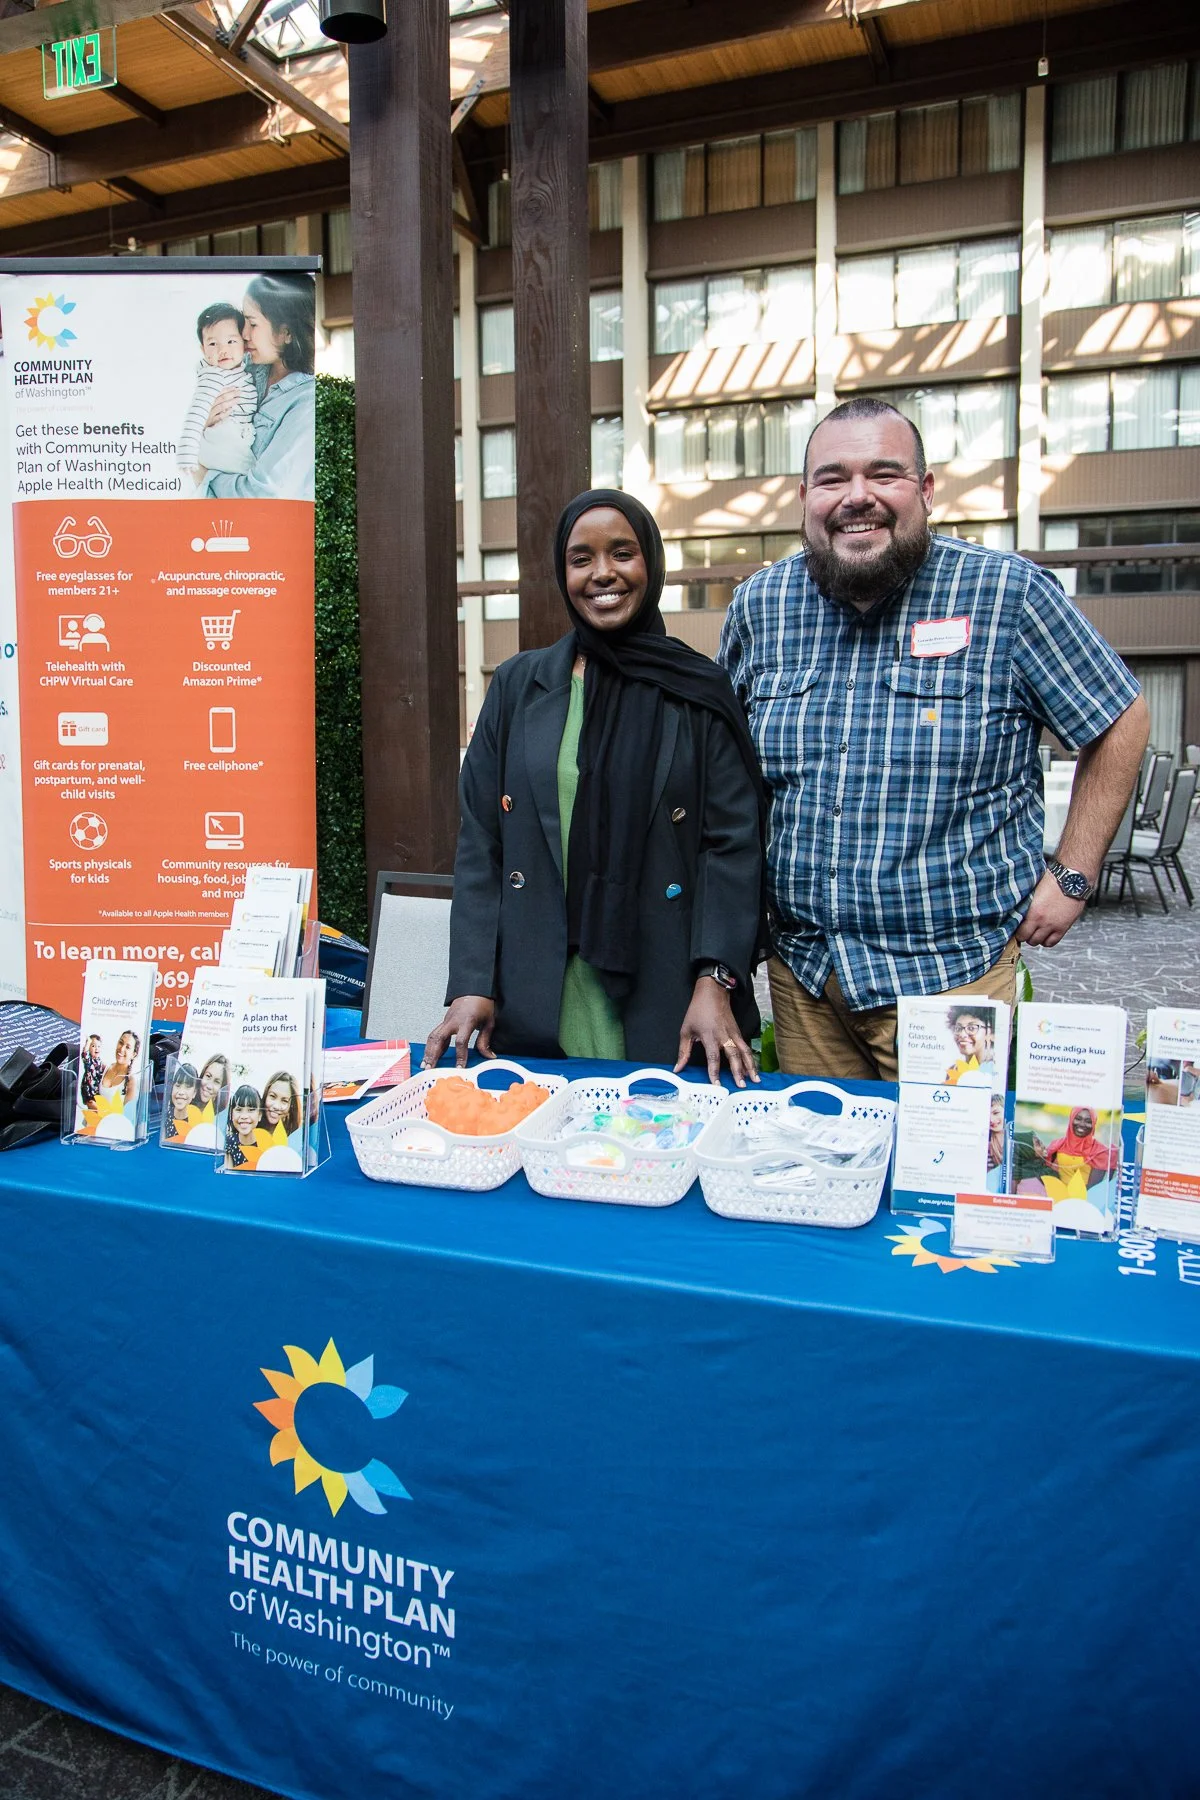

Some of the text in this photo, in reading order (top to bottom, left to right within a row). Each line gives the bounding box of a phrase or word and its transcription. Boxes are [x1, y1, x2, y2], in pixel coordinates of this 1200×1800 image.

[14, 359, 93, 373] COMMUNITY
[14, 372, 93, 386] HEALTH PLAN
[15, 388, 24, 399] of
[16, 422, 145, 438] Get these benefits
[16, 440, 177, 457] with Community Health
[17, 459, 151, 475] Plan of Washington
[17, 477, 182, 494] Apple Health (Medicaid)
[36, 570, 134, 583] Free eyeglasses for
[157, 570, 286, 583] Acupuncture, chiropractic,
[48, 586, 120, 596] members 21+
[166, 586, 278, 598] and massage coverage
[45, 661, 125, 672] Telehealth with
[192, 661, 252, 672] Discounted
[39, 676, 134, 687] CHPW Virtual Care
[182, 676, 225, 687] Amazon
[33, 760, 146, 773] Gift cards for prenatal,
[183, 760, 206, 771] Free
[34, 774, 146, 786] postpartum, and well-
[60, 789, 116, 800] child visits
[49, 858, 132, 871] Sports physicals
[161, 859, 290, 872] Community resources for
[70, 873, 110, 884] for kids
[157, 873, 202, 886] housing,
[203, 873, 230, 885] food,
[231, 873, 247, 885] job
[202, 888, 245, 898] and mor
[135, 910, 143, 918] to
[144, 910, 152, 918] all
[153, 910, 173, 919] Apple
[174, 910, 197, 918] Health
[198, 910, 229, 919] members
[34, 940, 222, 963] To learn more, cal
[91, 996, 138, 1008] ChildrenFirst
[200, 998, 216, 1008] plan
[217, 999, 233, 1008] that
[192, 1007, 236, 1018] puts you firs
[243, 1013, 288, 1023] A plan that
[242, 1024, 261, 1034] puts
[262, 1024, 278, 1034] you
[280, 1023, 298, 1032] first
[909, 1023, 925, 1031] Free
[908, 1031, 937, 1041] Glasses
[1159, 1035, 1194, 1044] Alternative
[907, 1041, 945, 1051] for Adults
[1030, 1041, 1106, 1056] Qorshe adiga kuu
[1029, 1052, 1087, 1066] horraysiinaya
[227, 1511, 455, 1600] COMMUNITY
[228, 1545, 456, 1639] HEALTH PLAN
[229, 1590, 259, 1615] of
[230, 1630, 455, 1721] The power of community
